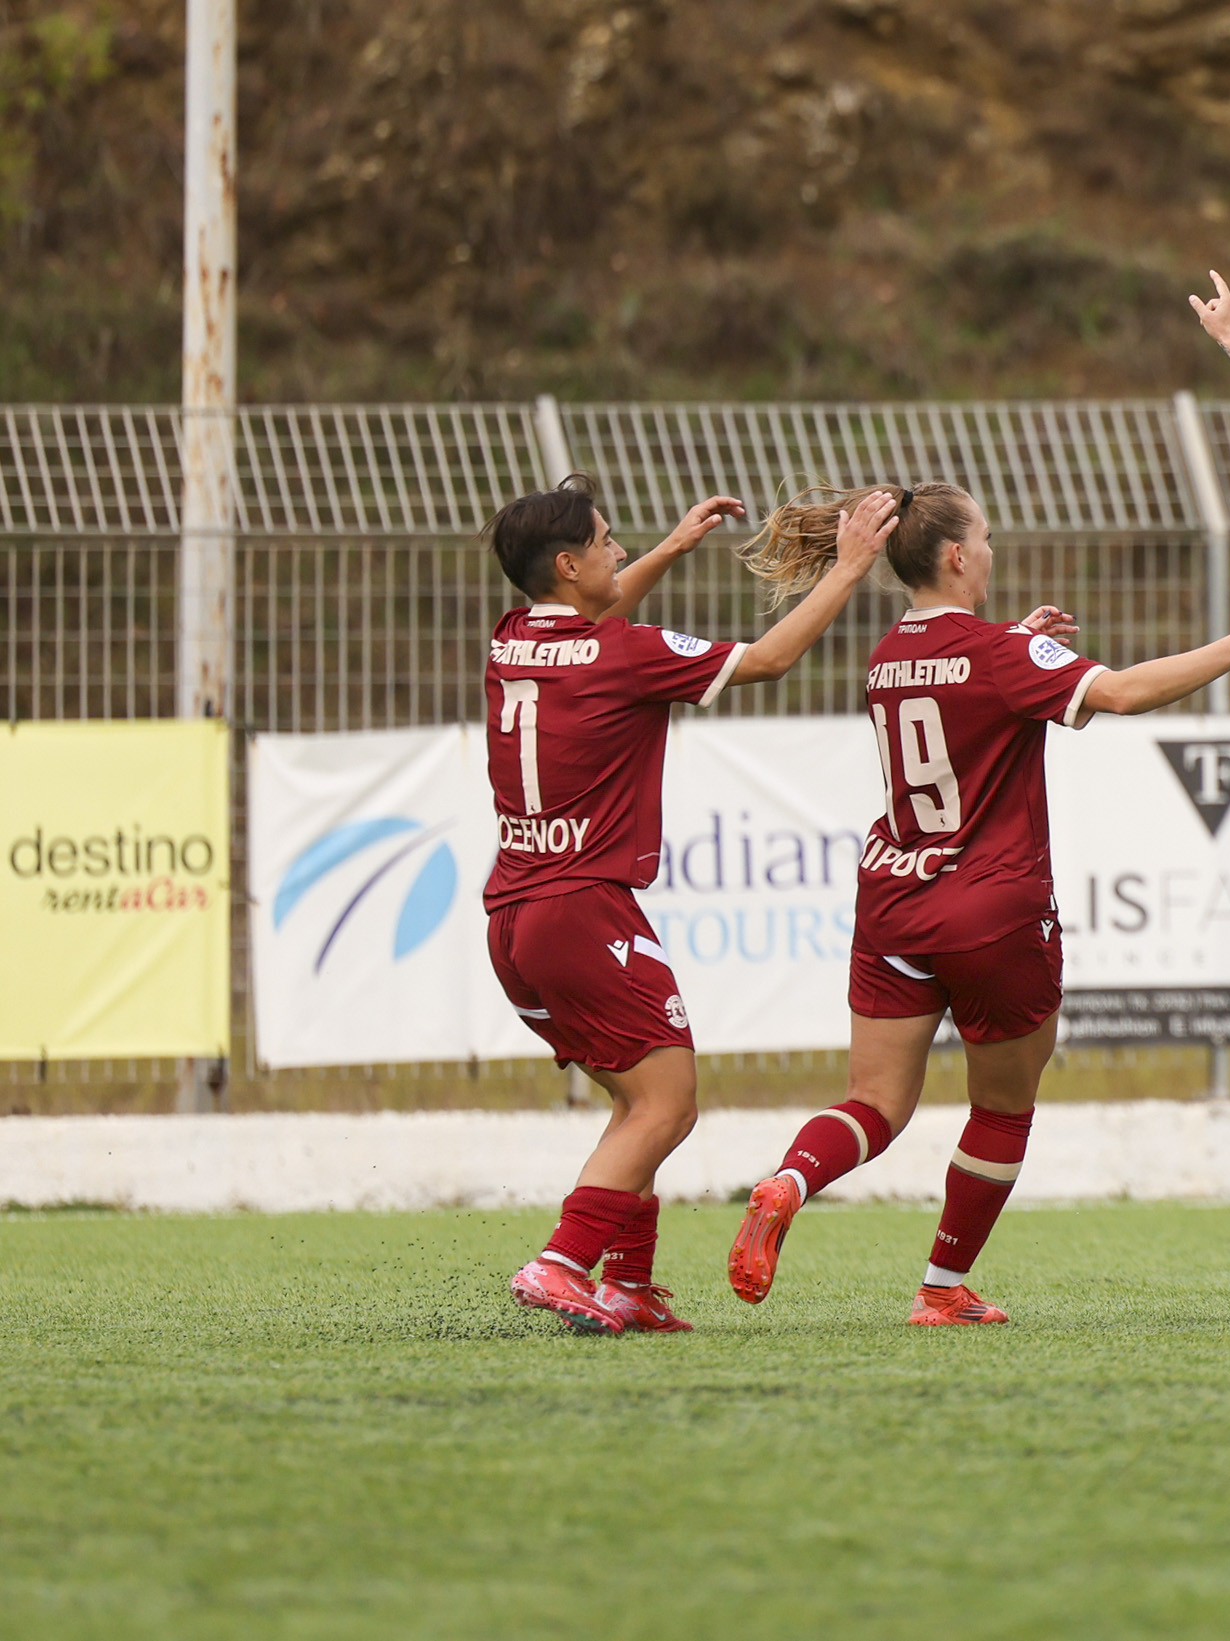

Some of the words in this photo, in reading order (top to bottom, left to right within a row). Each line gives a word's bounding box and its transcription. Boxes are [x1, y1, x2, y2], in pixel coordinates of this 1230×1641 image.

[500, 678, 542, 816] 7
[871, 696, 962, 843] 19
[9, 823, 214, 879] destino
[797, 1150, 820, 1168] 1931
[937, 1229, 958, 1246] 1931
